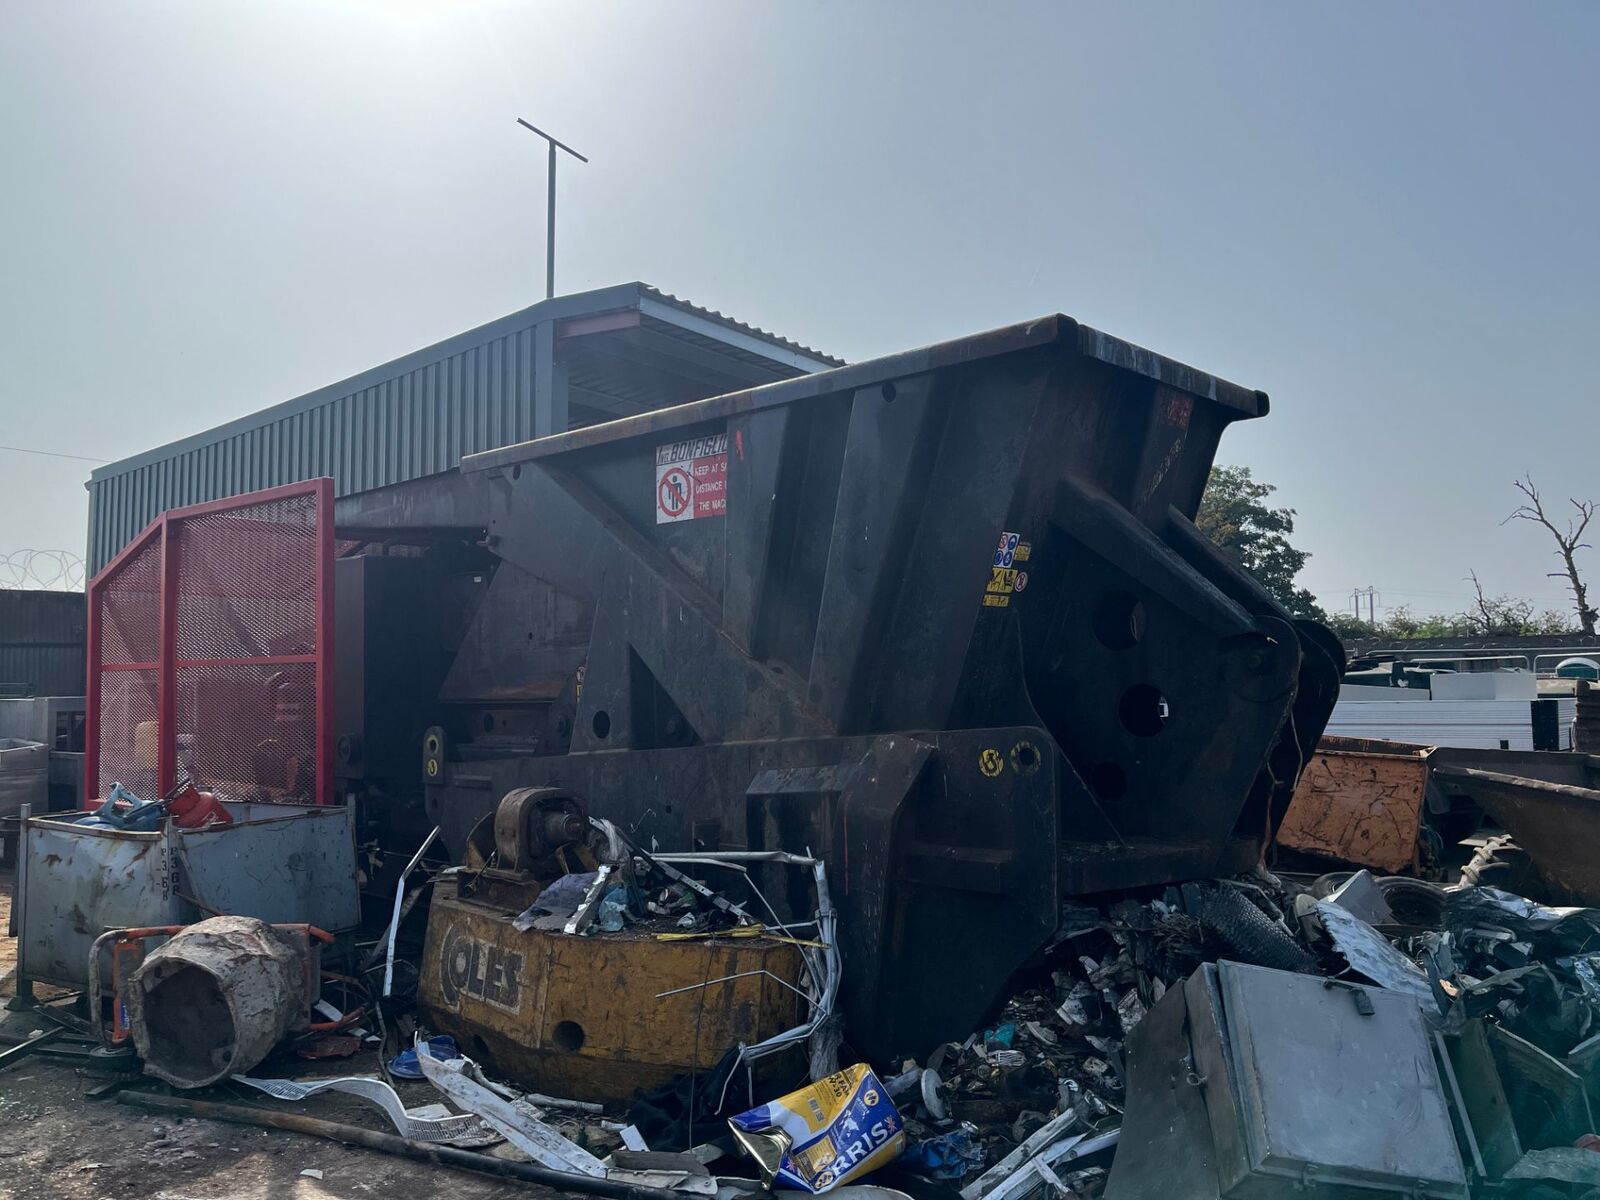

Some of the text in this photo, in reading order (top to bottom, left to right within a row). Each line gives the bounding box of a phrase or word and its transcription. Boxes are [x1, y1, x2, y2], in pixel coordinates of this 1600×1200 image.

[694, 465, 709, 477] KEEP
[711, 463, 719, 473] AT
[695, 480, 722, 494] DISTANCE
[698, 498, 726, 511] THE MAC
[440, 919, 525, 1014] COLES
[824, 1121, 889, 1180] RRIS
